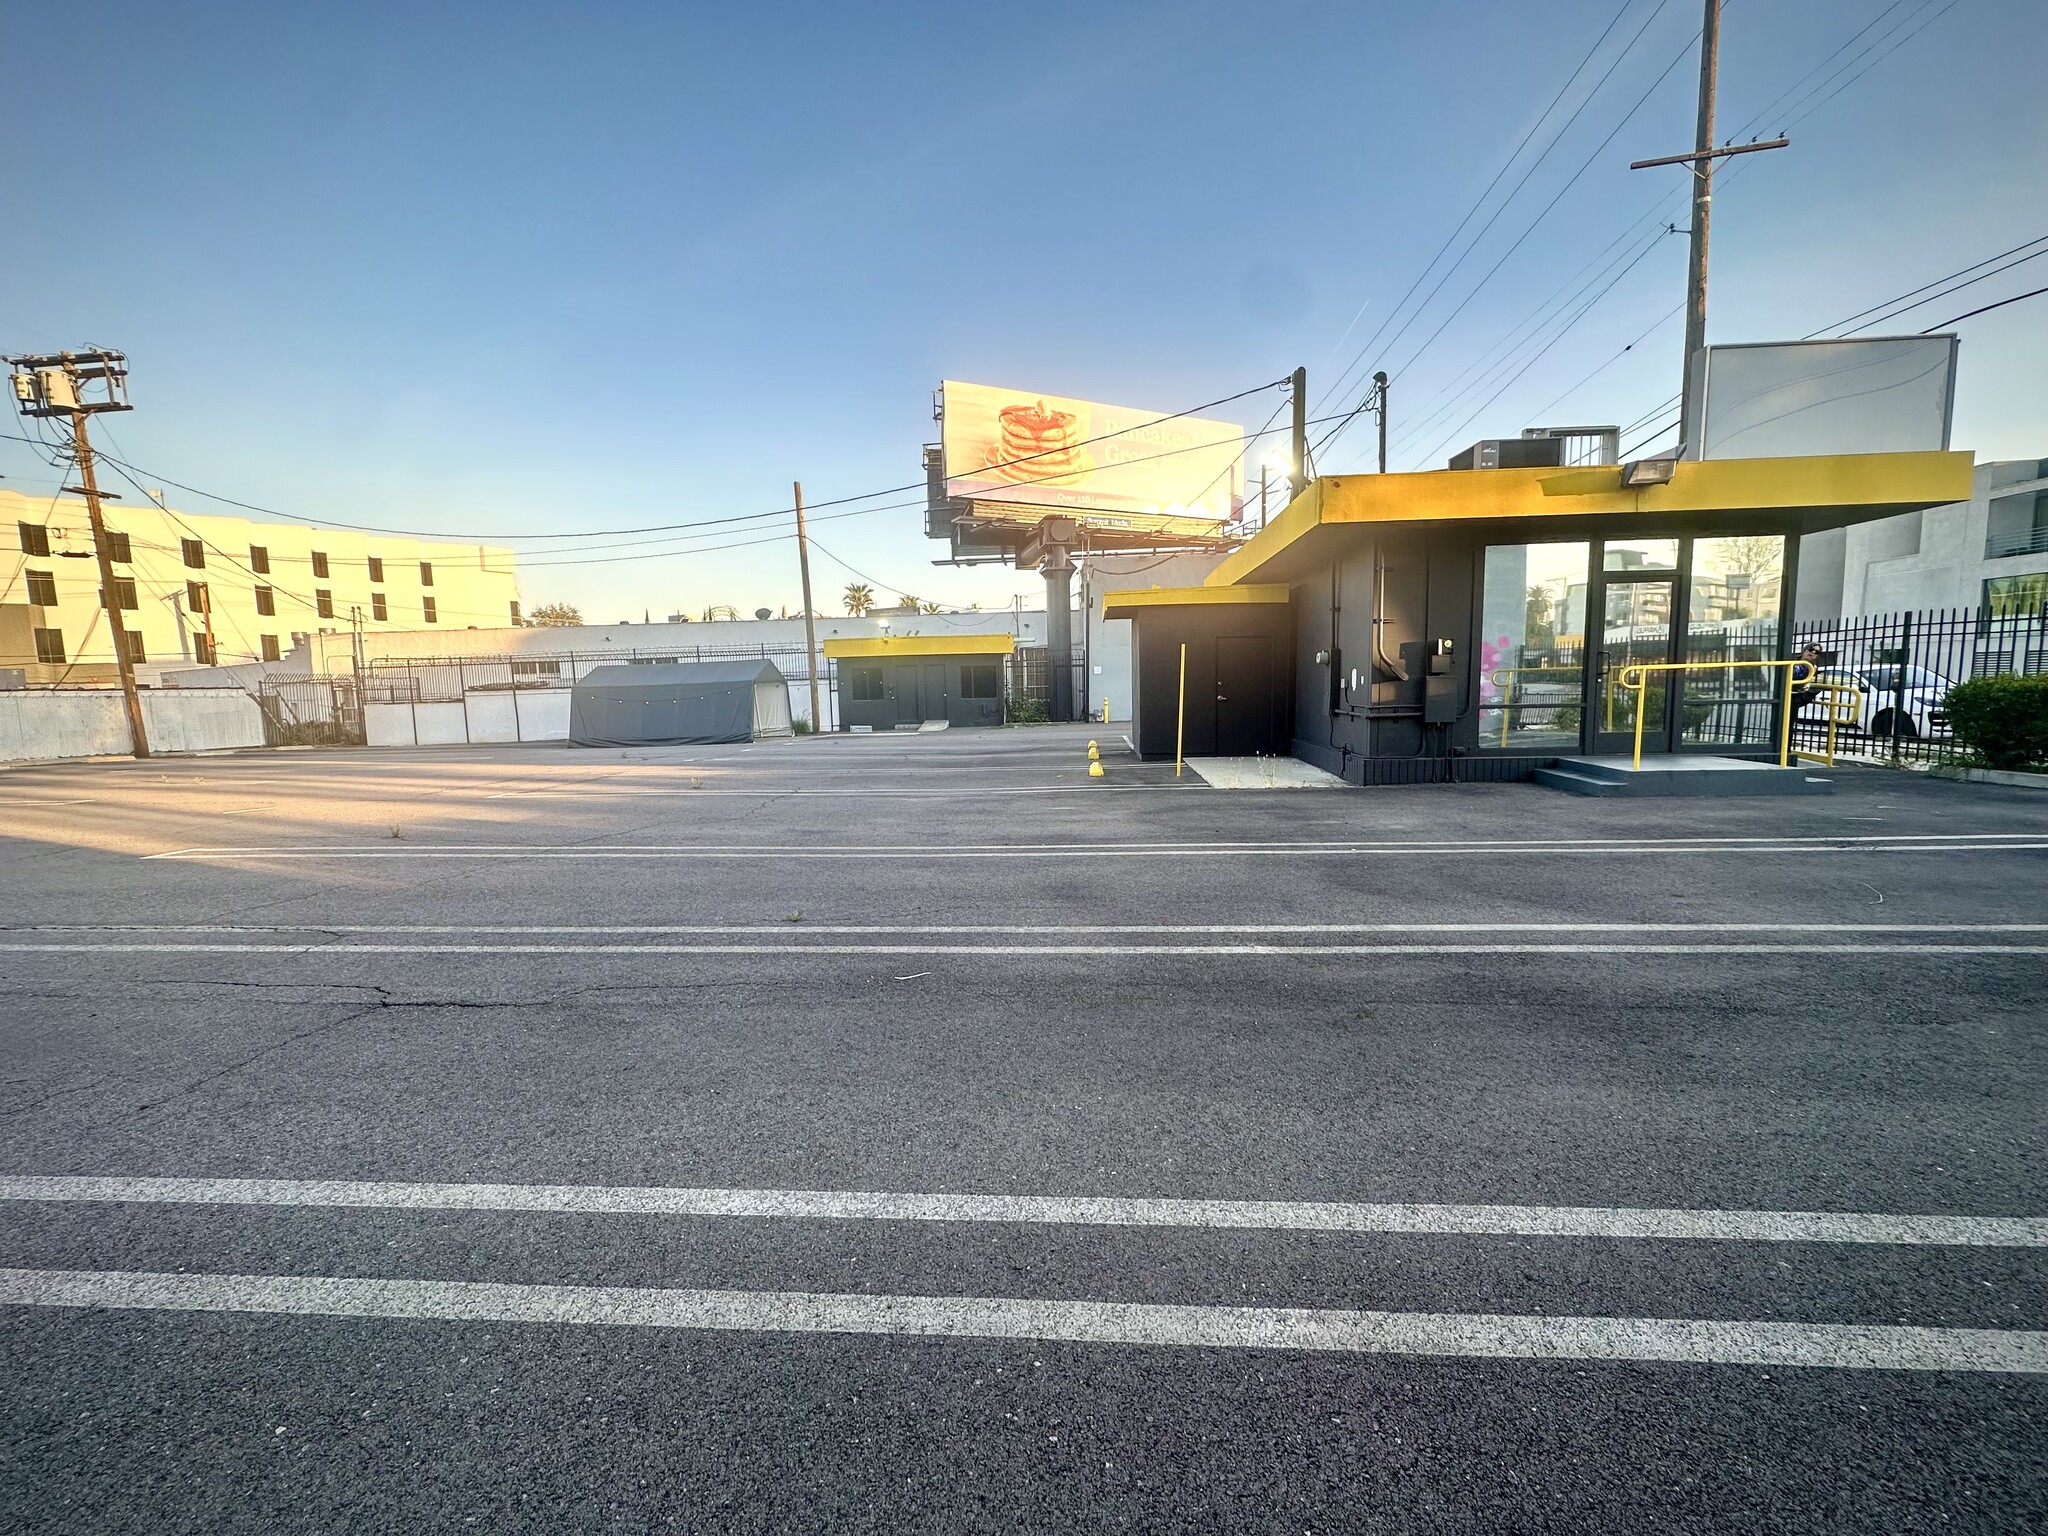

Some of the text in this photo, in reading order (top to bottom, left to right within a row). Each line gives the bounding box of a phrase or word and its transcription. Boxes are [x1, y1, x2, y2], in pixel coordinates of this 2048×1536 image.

[1105, 420, 1197, 447] Pancakes?
[1057, 493, 1076, 503] Over
[1077, 495, 1090, 504] 110
